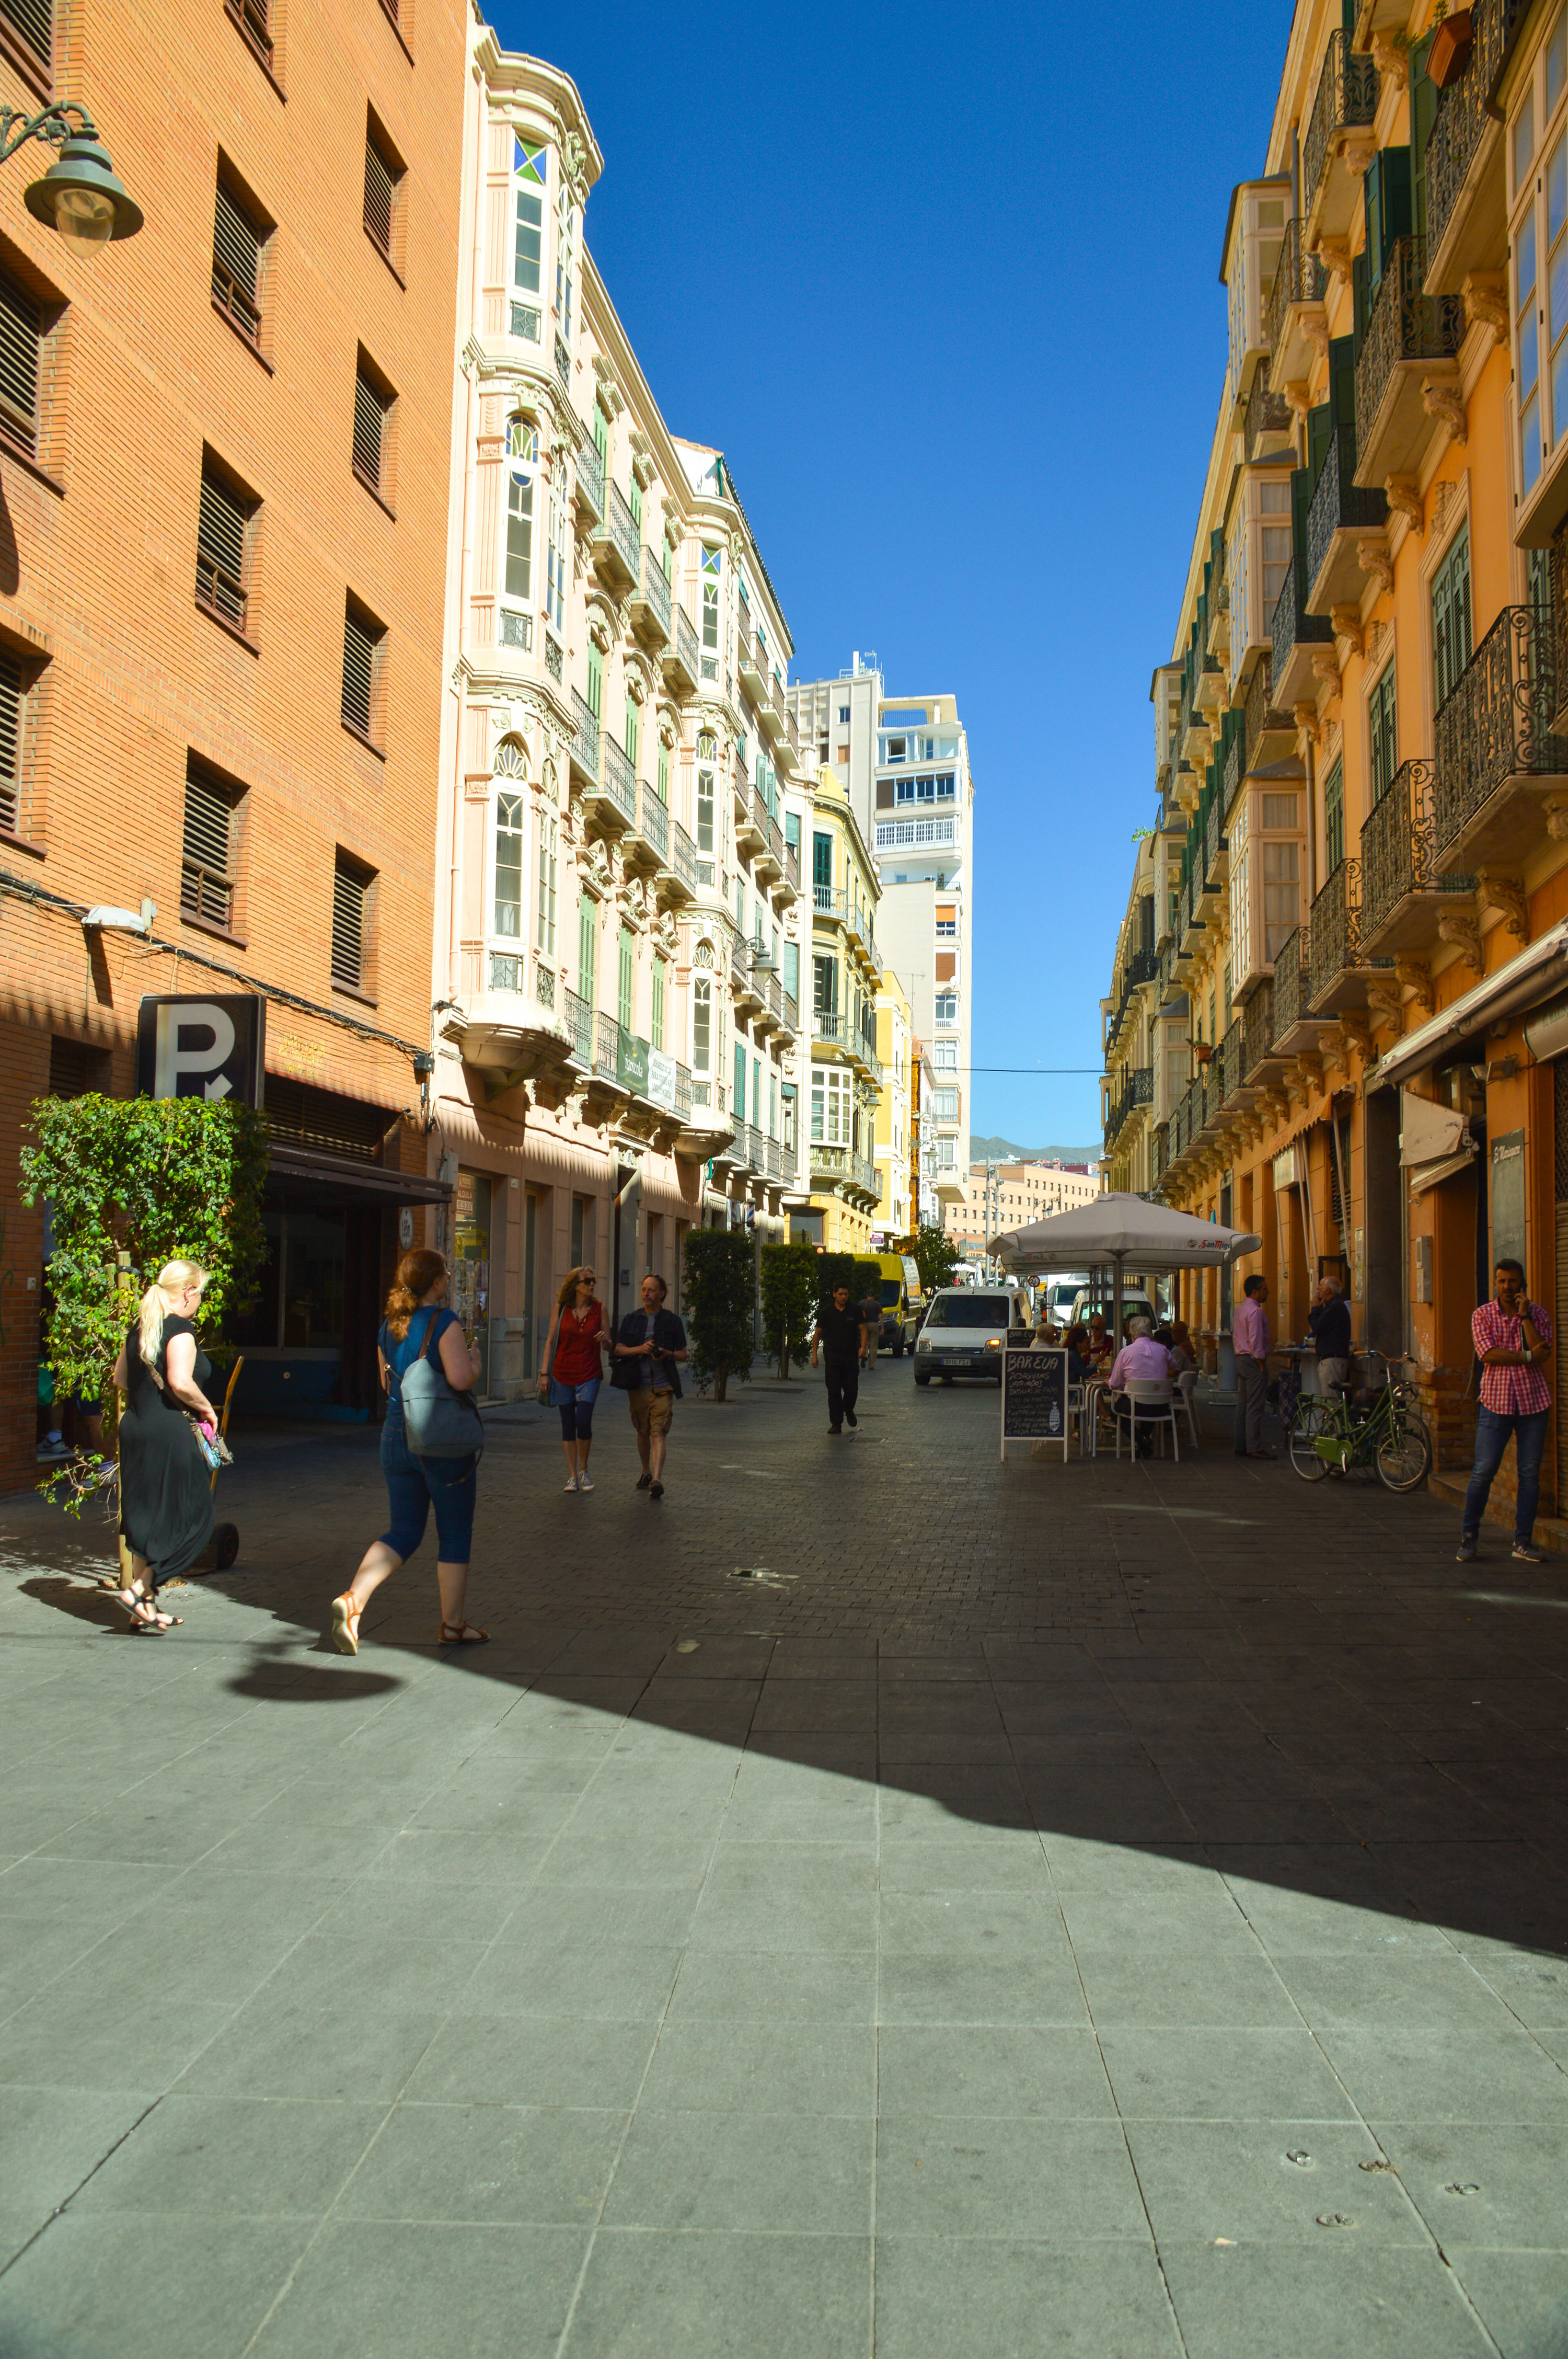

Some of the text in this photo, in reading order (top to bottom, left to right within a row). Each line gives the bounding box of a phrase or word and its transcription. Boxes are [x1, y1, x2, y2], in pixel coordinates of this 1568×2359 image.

[155, 1003, 235, 1101] P
[458, 1190, 472, 1199] ALQUILA
[1215, 1240, 1231, 1250] Migu
[1007, 1355, 1033, 1372] BAR
[1008, 1372, 1050, 1381] DESAYUNOS
